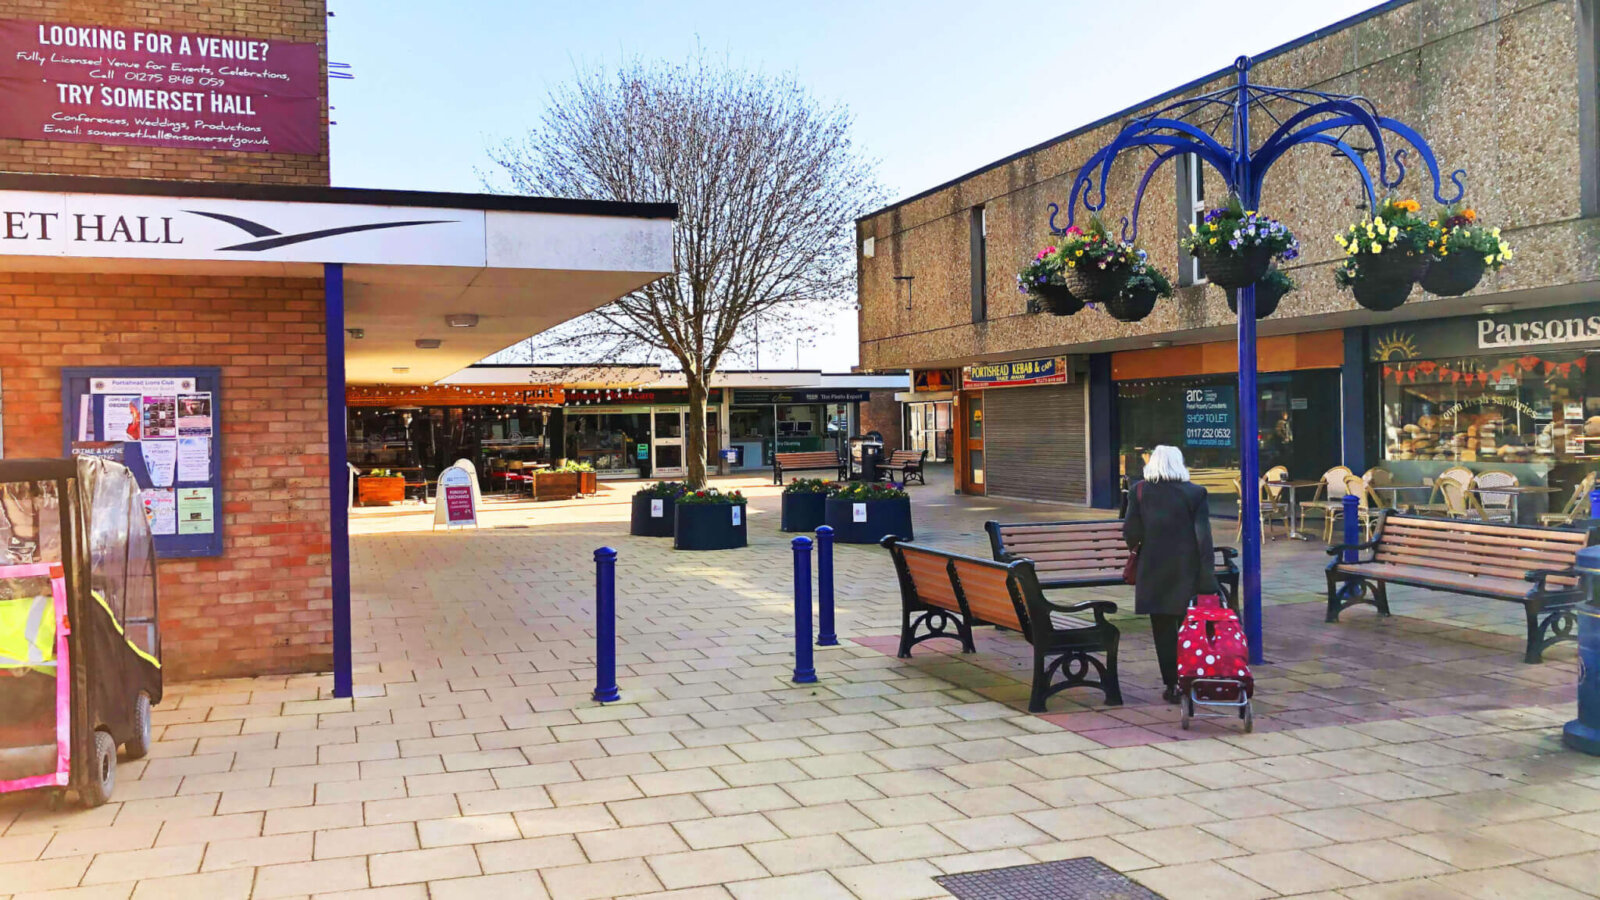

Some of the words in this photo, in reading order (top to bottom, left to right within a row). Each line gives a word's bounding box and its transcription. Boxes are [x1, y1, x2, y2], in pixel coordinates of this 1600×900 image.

[39, 24, 126, 50] LOOKING
[134, 32, 172, 54] FOR
[179, 36, 192, 56] A
[197, 37, 269, 61] VENUE?
[16, 51, 46, 66] Fully
[50, 53, 102, 65] Licensed
[107, 58, 140, 68] Venue
[145, 60, 166, 70] for
[171, 63, 214, 75] Events,
[218, 66, 290, 81] Celebrations,
[89, 69, 114, 80] Call
[125, 71, 163, 83] 01275
[168, 74, 194, 85] 848
[199, 76, 225, 87] 059
[56, 83, 94, 105] TRY
[101, 86, 205, 112] SOMERSET
[211, 93, 256, 115] HALL
[43, 124, 82, 135] Email:
[51, 112, 130, 127] Conferences,
[134, 117, 190, 132] Weddings,
[194, 120, 262, 133] Productions
[3, 211, 59, 241] ET
[73, 213, 184, 244] HALL
[1478, 315, 1600, 348] Parsons
[971, 363, 1009, 379] PORTISHEAD
[1012, 361, 1033, 375] KEBAB
[1034, 361, 1040, 373] &
[1186, 389, 1203, 402] arc
[1463, 392, 1489, 408] fresh
[1491, 395, 1538, 419] savouries
[1186, 413, 1204, 423] SHOP
[1205, 413, 1215, 423] TO
[1215, 413, 1228, 423] LET
[1186, 428, 1201, 438] 0117
[1202, 428, 1214, 438] 252
